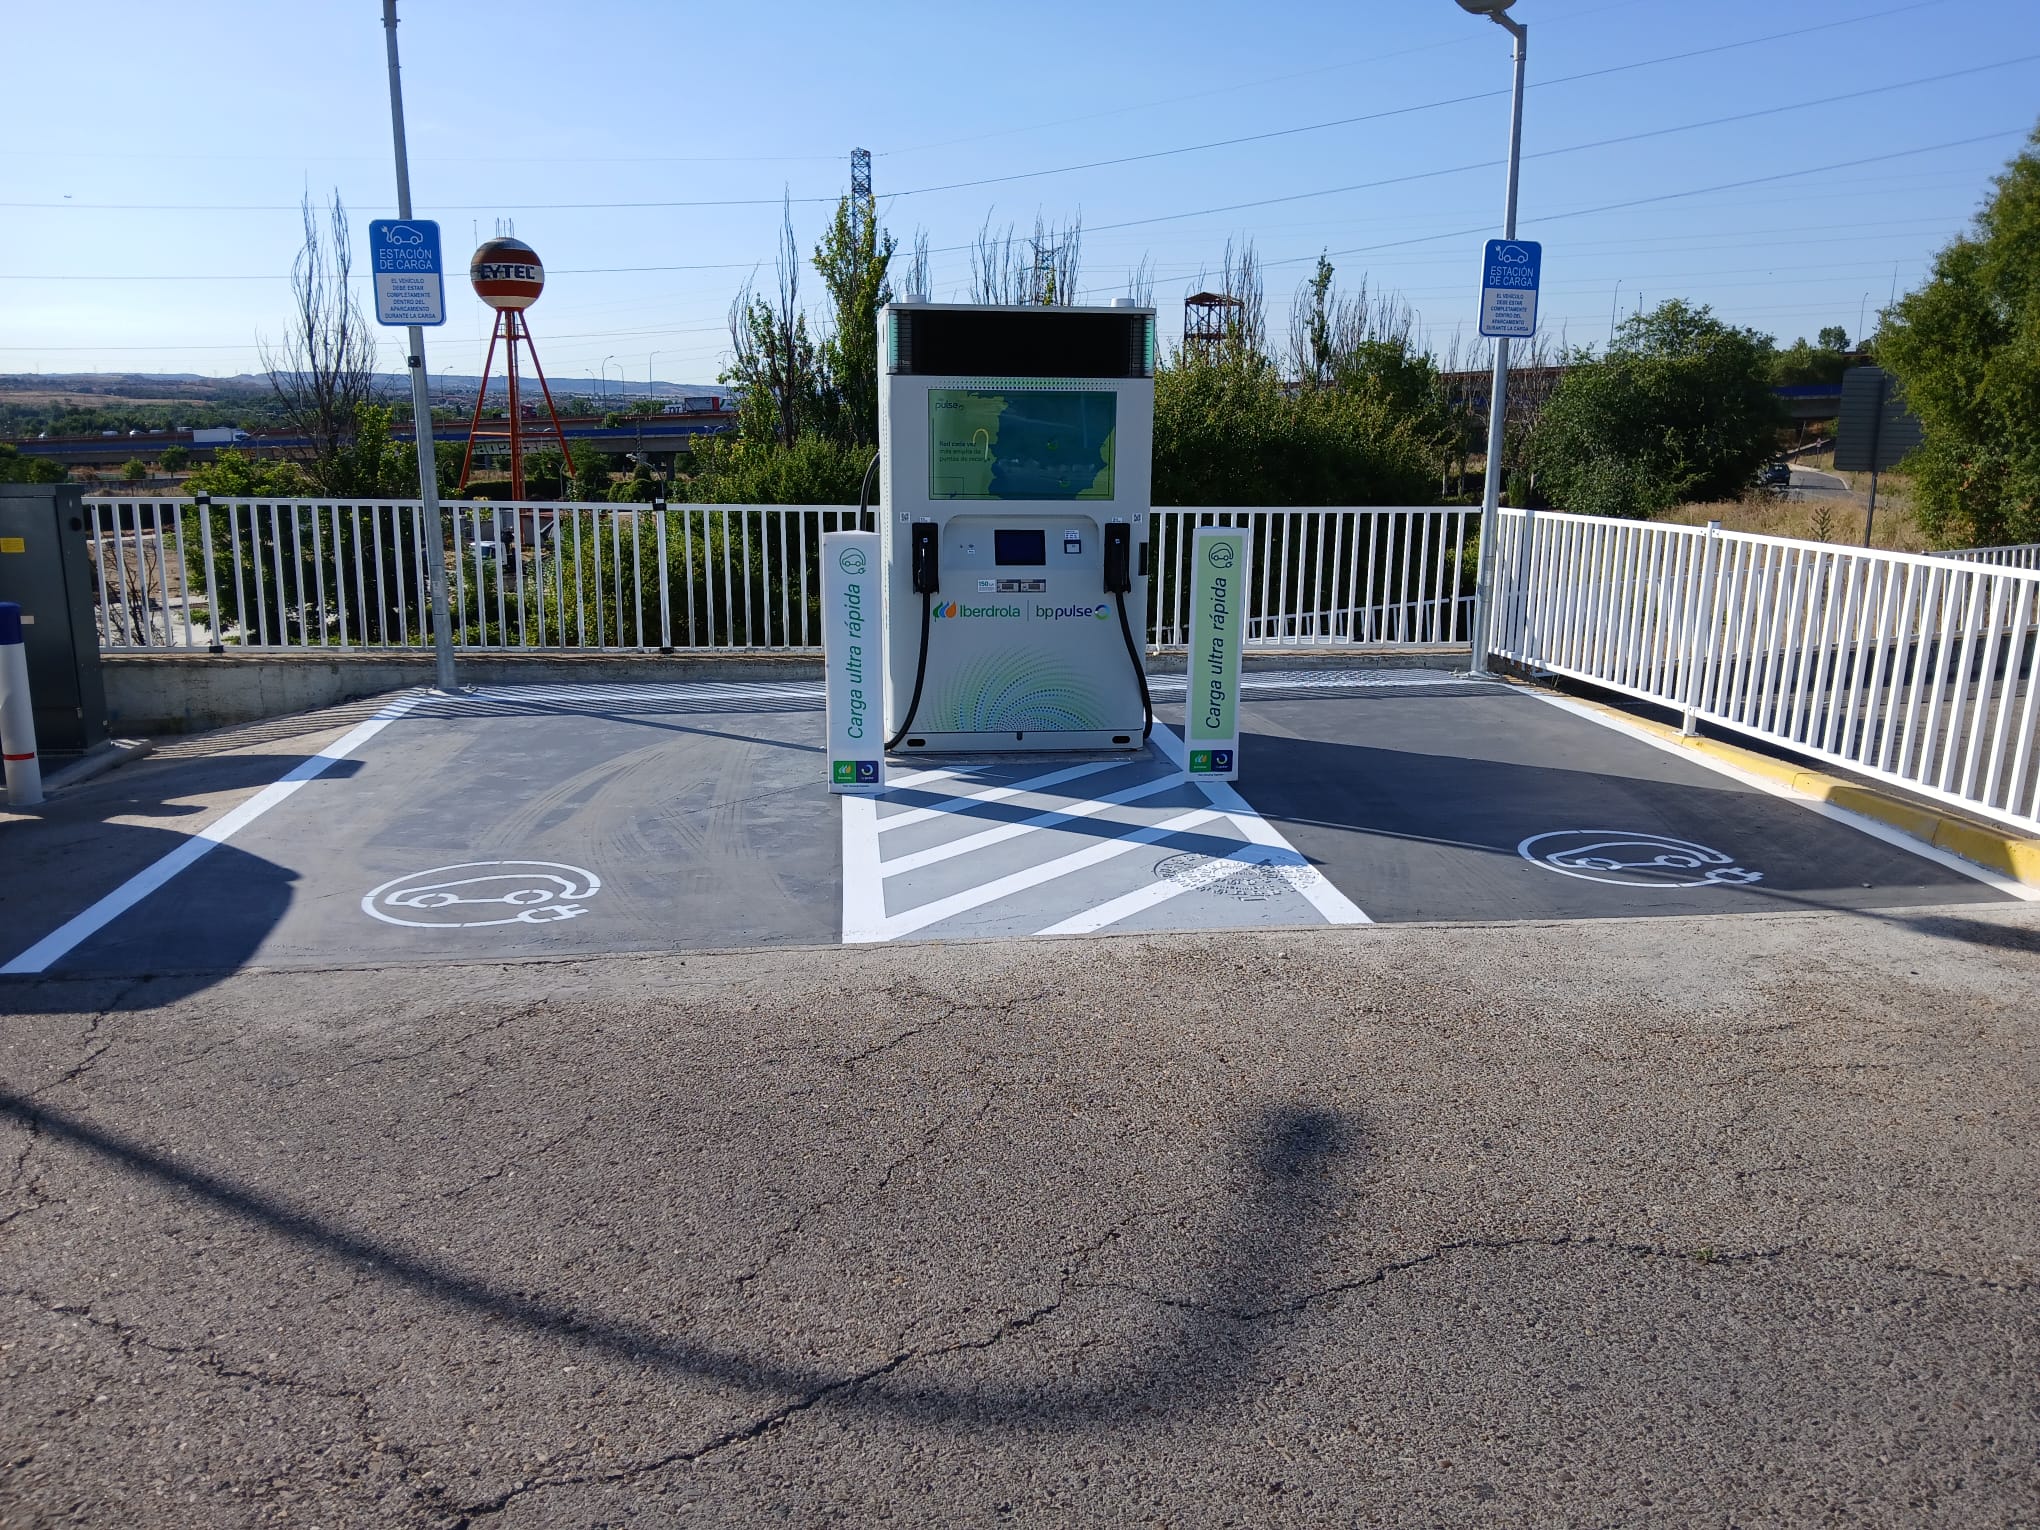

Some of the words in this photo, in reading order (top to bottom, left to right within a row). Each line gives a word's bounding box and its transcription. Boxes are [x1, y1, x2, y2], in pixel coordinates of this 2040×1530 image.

[379, 247, 432, 259] ESTACIÓN
[379, 259, 394, 270] DE
[396, 259, 433, 270] CARGA
[1490, 265, 1534, 278] ESTACIÓN
[1489, 276, 1501, 286] DE
[1503, 276, 1533, 287] CARGA
[843, 583, 866, 638] rápida
[959, 604, 1021, 618] Iberdrola
[1208, 577, 1229, 631] rápida
[845, 644, 862, 684] ultra
[1207, 637, 1224, 675] ultra
[847, 688, 867, 739] Carga
[1205, 680, 1225, 729] Carga
